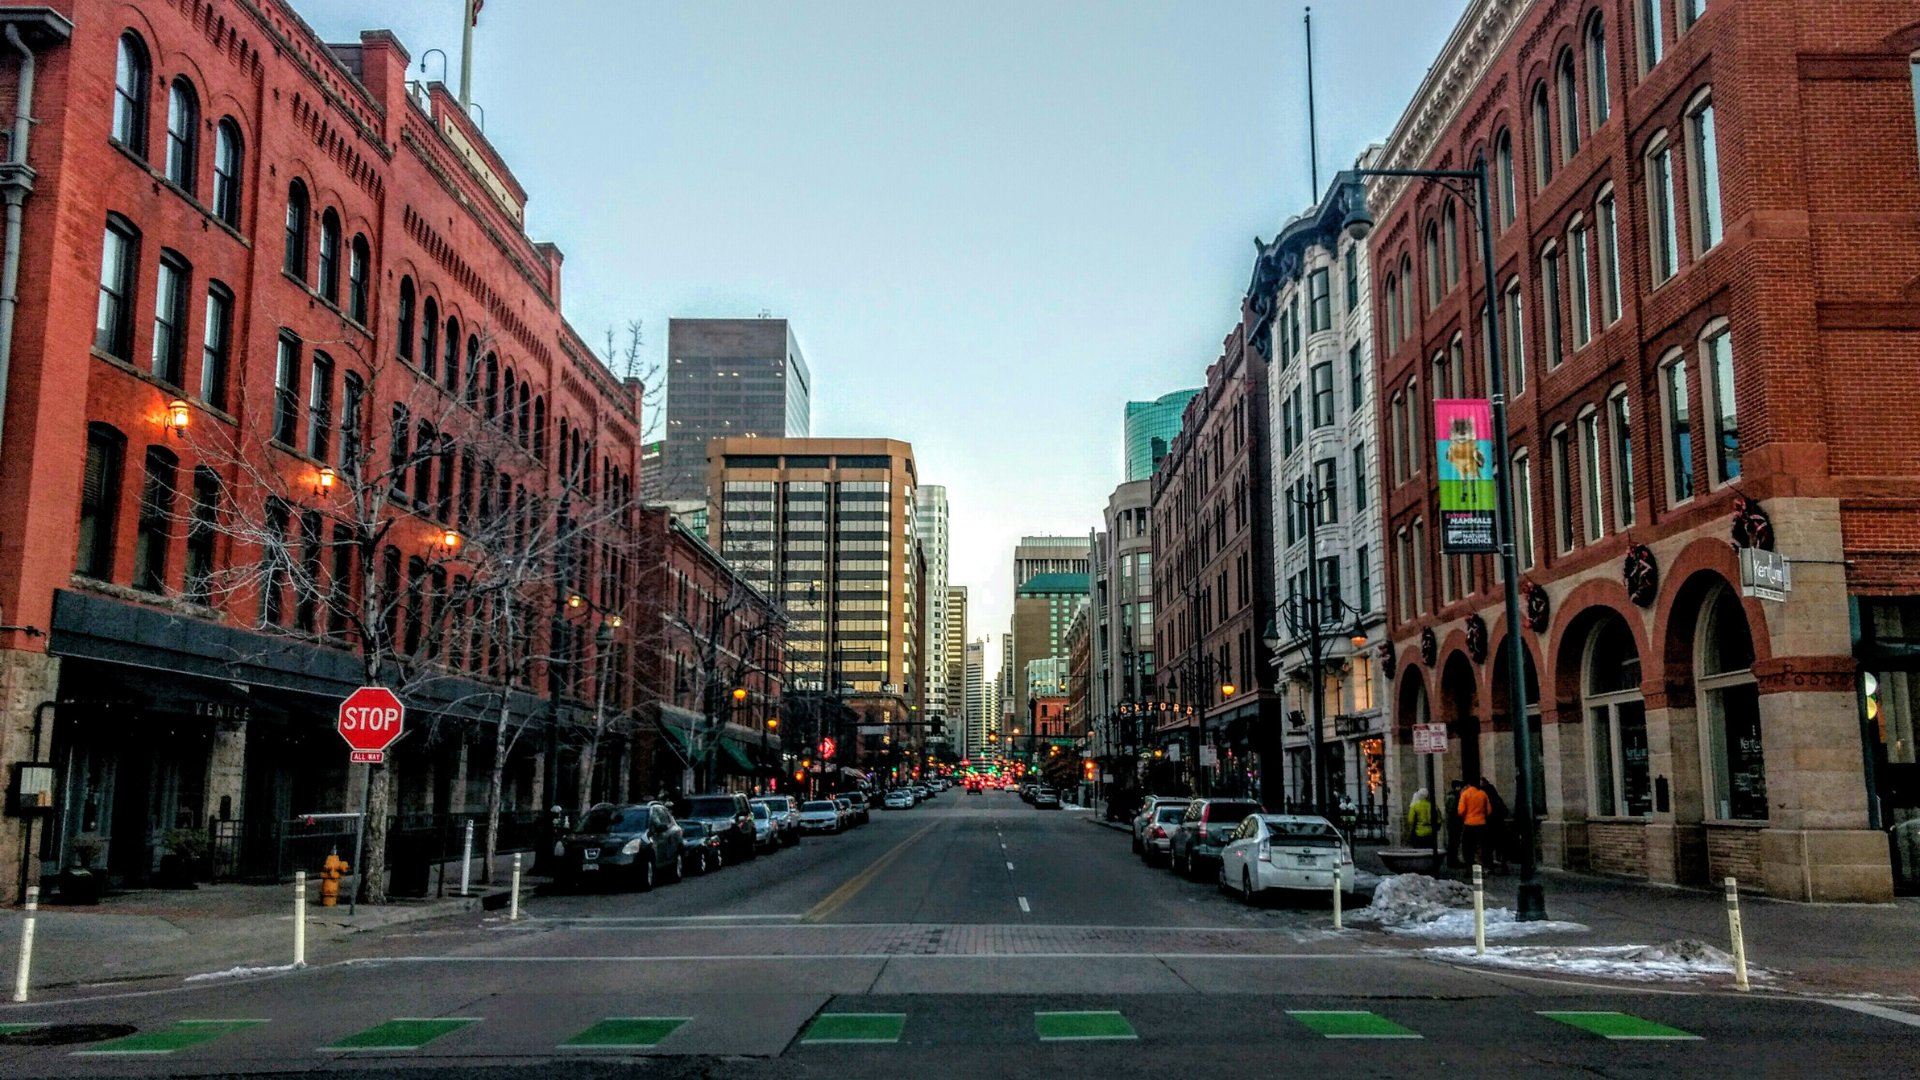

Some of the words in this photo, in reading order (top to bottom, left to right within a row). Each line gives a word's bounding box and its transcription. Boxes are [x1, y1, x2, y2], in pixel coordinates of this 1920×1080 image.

[1450, 517, 1493, 525] MAMMALS
[195, 702, 251, 720] VENICE
[1119, 702, 1194, 716] OXFORD
[343, 707, 399, 731] STOP
